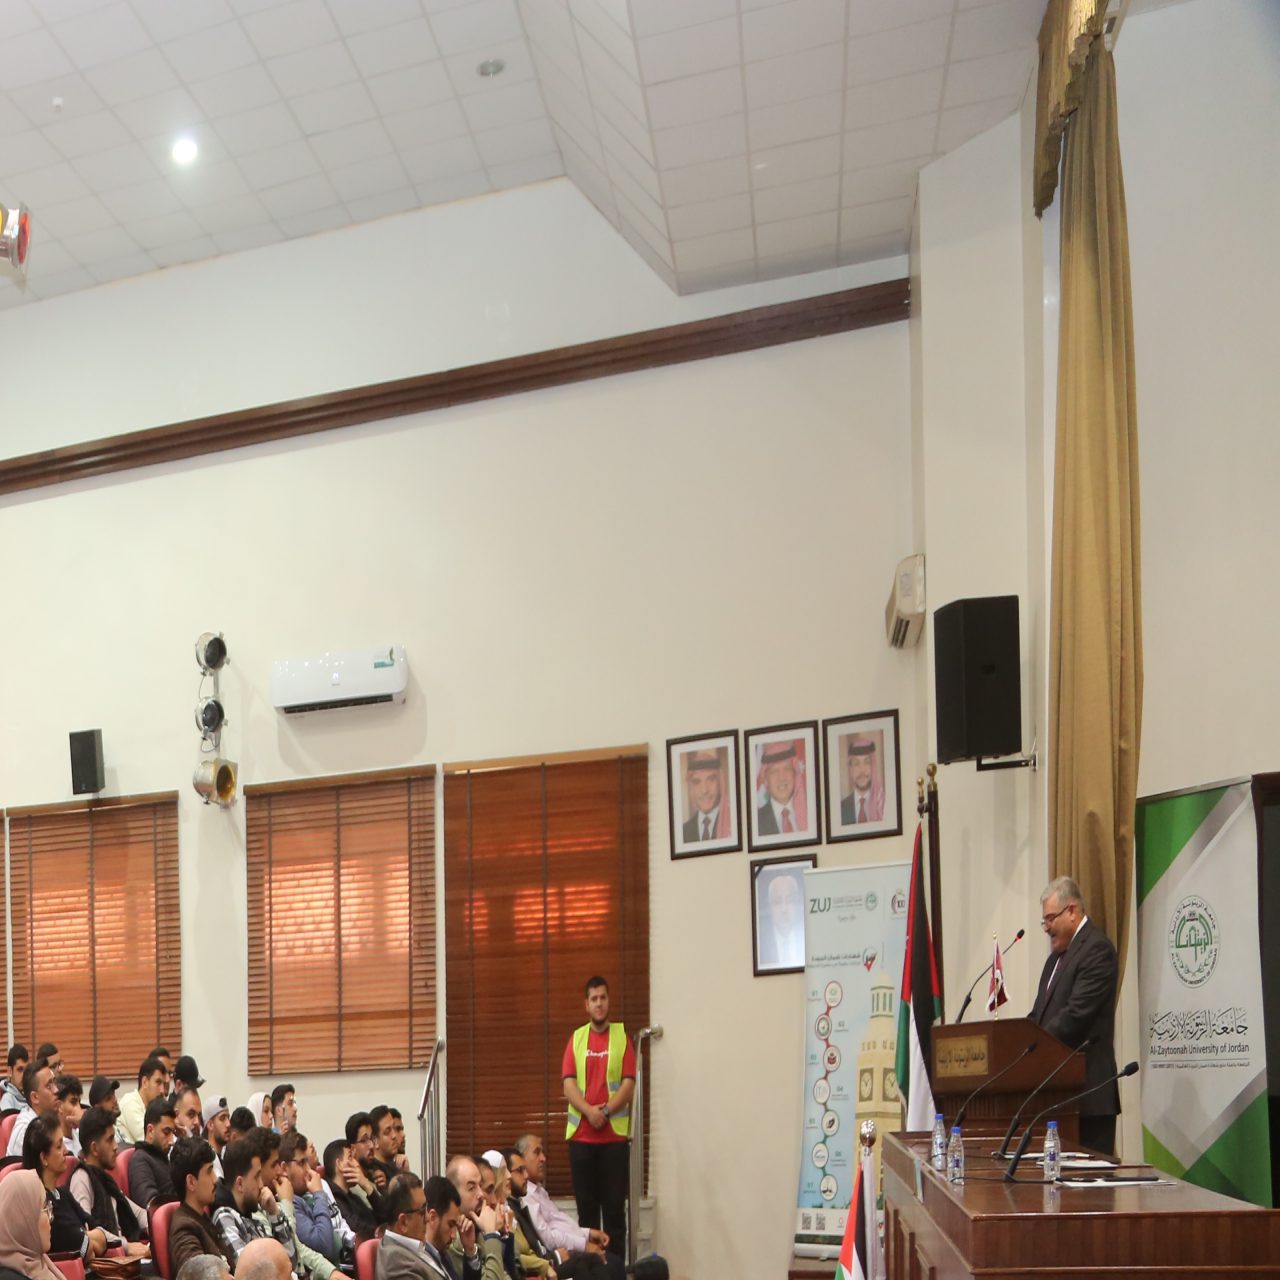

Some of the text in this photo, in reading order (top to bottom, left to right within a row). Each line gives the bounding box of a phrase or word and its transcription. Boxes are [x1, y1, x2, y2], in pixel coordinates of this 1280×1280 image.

[810, 897, 831, 914] ZUJ
[1150, 1043, 1249, 1056] Al-Zaytoonah University of Jordan
